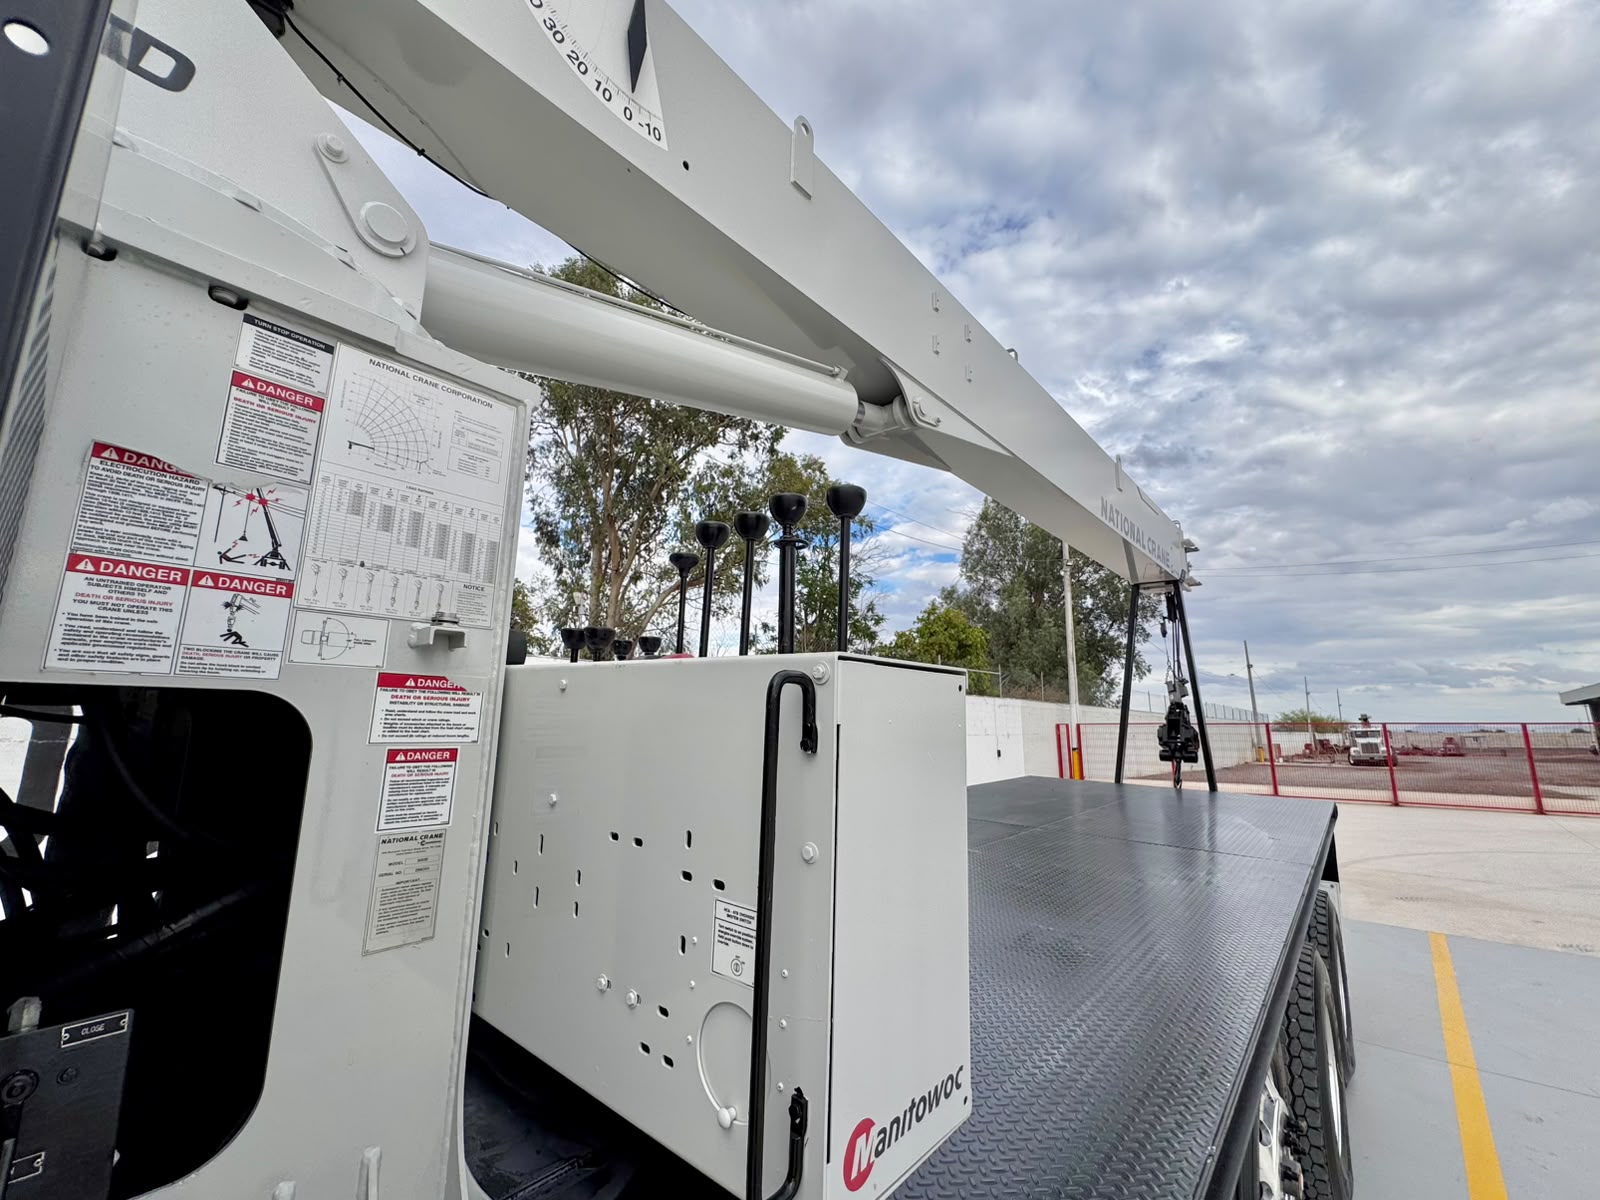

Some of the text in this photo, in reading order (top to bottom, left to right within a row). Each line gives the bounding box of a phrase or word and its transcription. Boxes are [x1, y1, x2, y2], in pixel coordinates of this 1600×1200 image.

[543, 17, 565, 44] 30
[566, 50, 588, 76] 20
[594, 79, 612, 102] 10
[624, 106, 632, 121] 0
[638, 122, 662, 142] -10
[254, 319, 325, 348] TURN STOP OPERATION
[256, 381, 313, 406] DANGER
[369, 358, 410, 379] NATIONAL
[412, 374, 439, 389] CRANE
[440, 384, 492, 408] CORPORATION
[233, 396, 254, 406] DEATH
[267, 406, 293, 417] SERIOUS
[295, 414, 316, 423] INJURY
[99, 460, 199, 485] ELECTROCUTION HAZARD
[124, 452, 176, 472] DANG
[100, 467, 121, 475] AVOID
[122, 471, 144, 479] DEATH
[156, 478, 183, 487] SERIOUS
[1100, 496, 1170, 562] NATIONAL CRANE
[99, 560, 182, 581] DANGER
[95, 578, 135, 586] UNTRAINED
[218, 577, 287, 595] DANGER
[463, 583, 484, 591] NOTICE
[406, 751, 449, 759] DANGER
[381, 836, 418, 844] NATIONAL
[843, 1065, 963, 1192] Manitowoc
